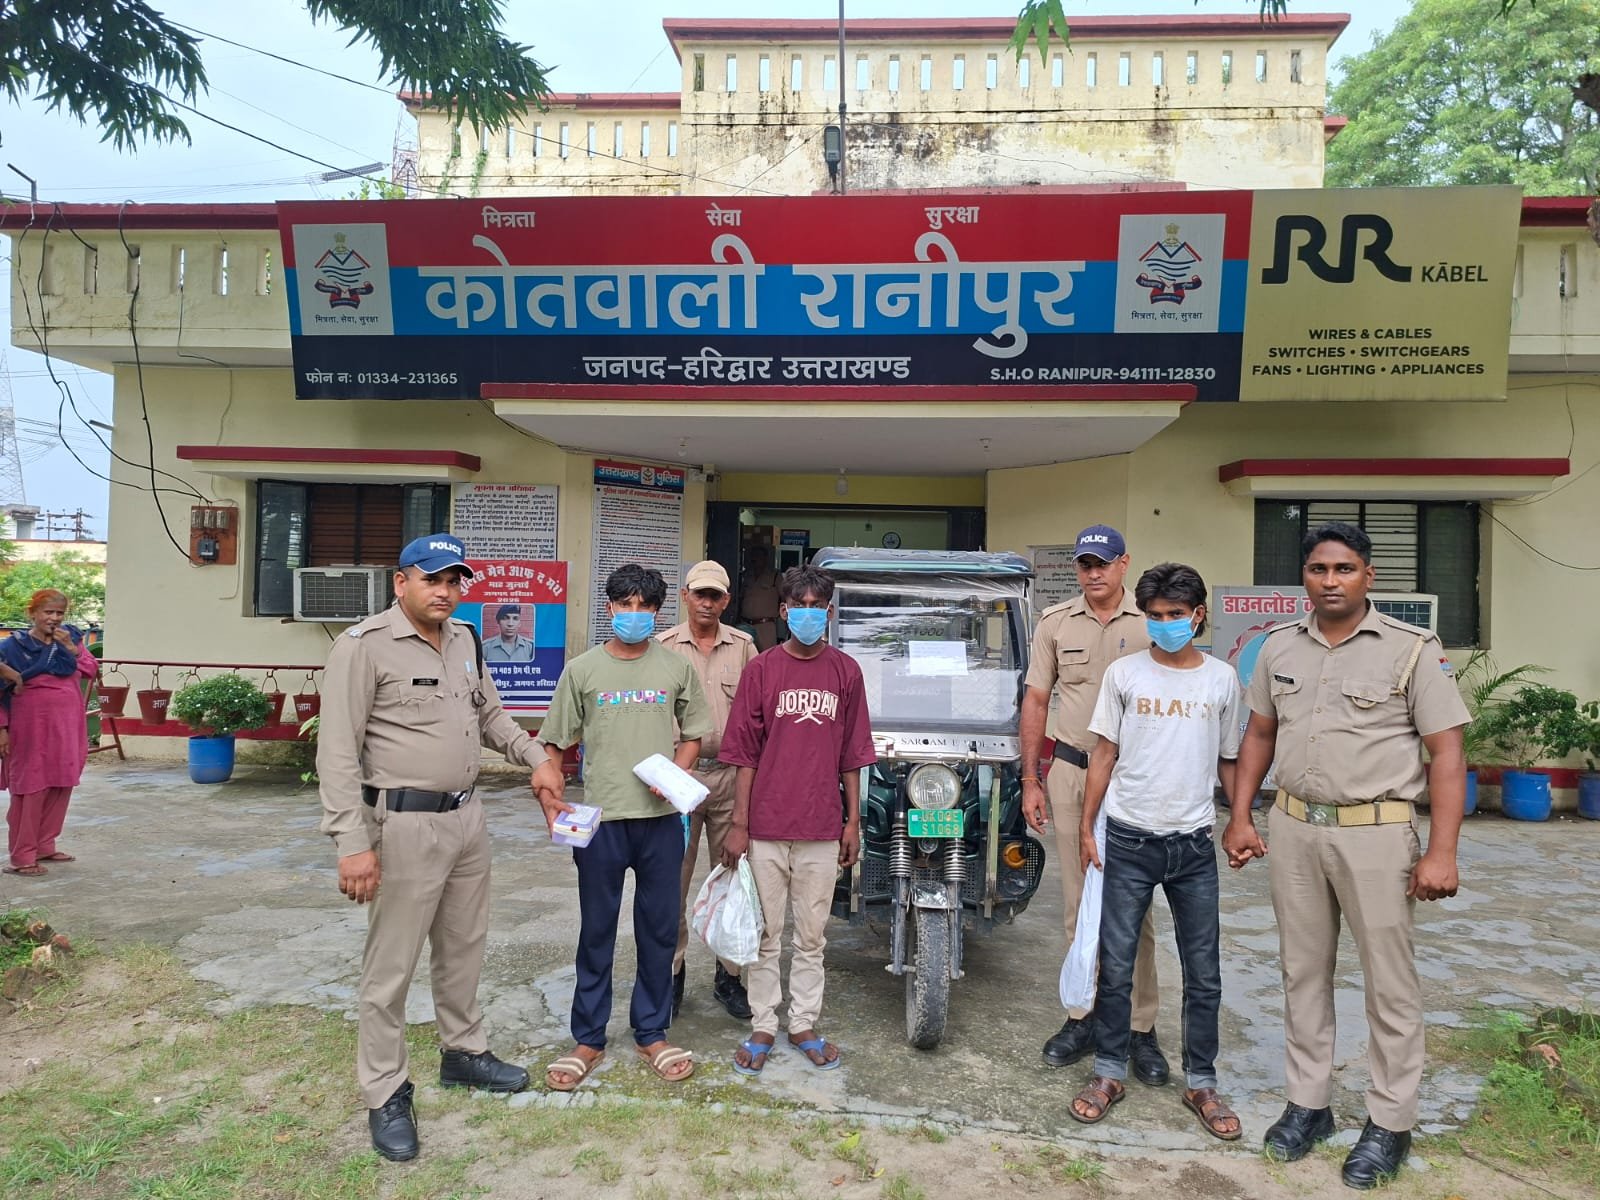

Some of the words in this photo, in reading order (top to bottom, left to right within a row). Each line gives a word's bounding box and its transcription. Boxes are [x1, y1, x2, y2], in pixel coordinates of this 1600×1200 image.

[482, 206, 536, 229] मित्रता
[706, 202, 742, 227] सेवा
[925, 205, 980, 229] सुरक्षा
[1261, 214, 1412, 284] RR
[418, 233, 766, 330] कोतवाली
[793, 231, 1086, 359] रानीपुर
[1180, 311, 1203, 322] सुरक्षा
[1308, 329, 1357, 340] WIRES
[1360, 329, 1370, 340] &
[1374, 328, 1433, 339] CABLES
[1268, 347, 1346, 358] SWITCHES
[1360, 346, 1470, 357] SWITCHGEARS
[582, 346, 773, 381] जनपद-हरिद्वार
[782, 356, 912, 380] उत्तराखण्ड
[1252, 365, 1292, 376] FANS
[1306, 364, 1376, 376] LIGHTING
[1390, 363, 1485, 375] APPLIANCES
[306, 368, 336, 385] फोन
[357, 371, 458, 385] 01334-231365
[990, 367, 1034, 381] S.H.O
[1038, 367, 1216, 381] RANIPUR-94111-12830
[1080, 534, 1109, 544] POLICE
[1222, 591, 1298, 614] डाउनलोड
[597, 689, 667, 706] FUTURE
[775, 689, 839, 721] JORDAN
[900, 737, 947, 747] SARAM
